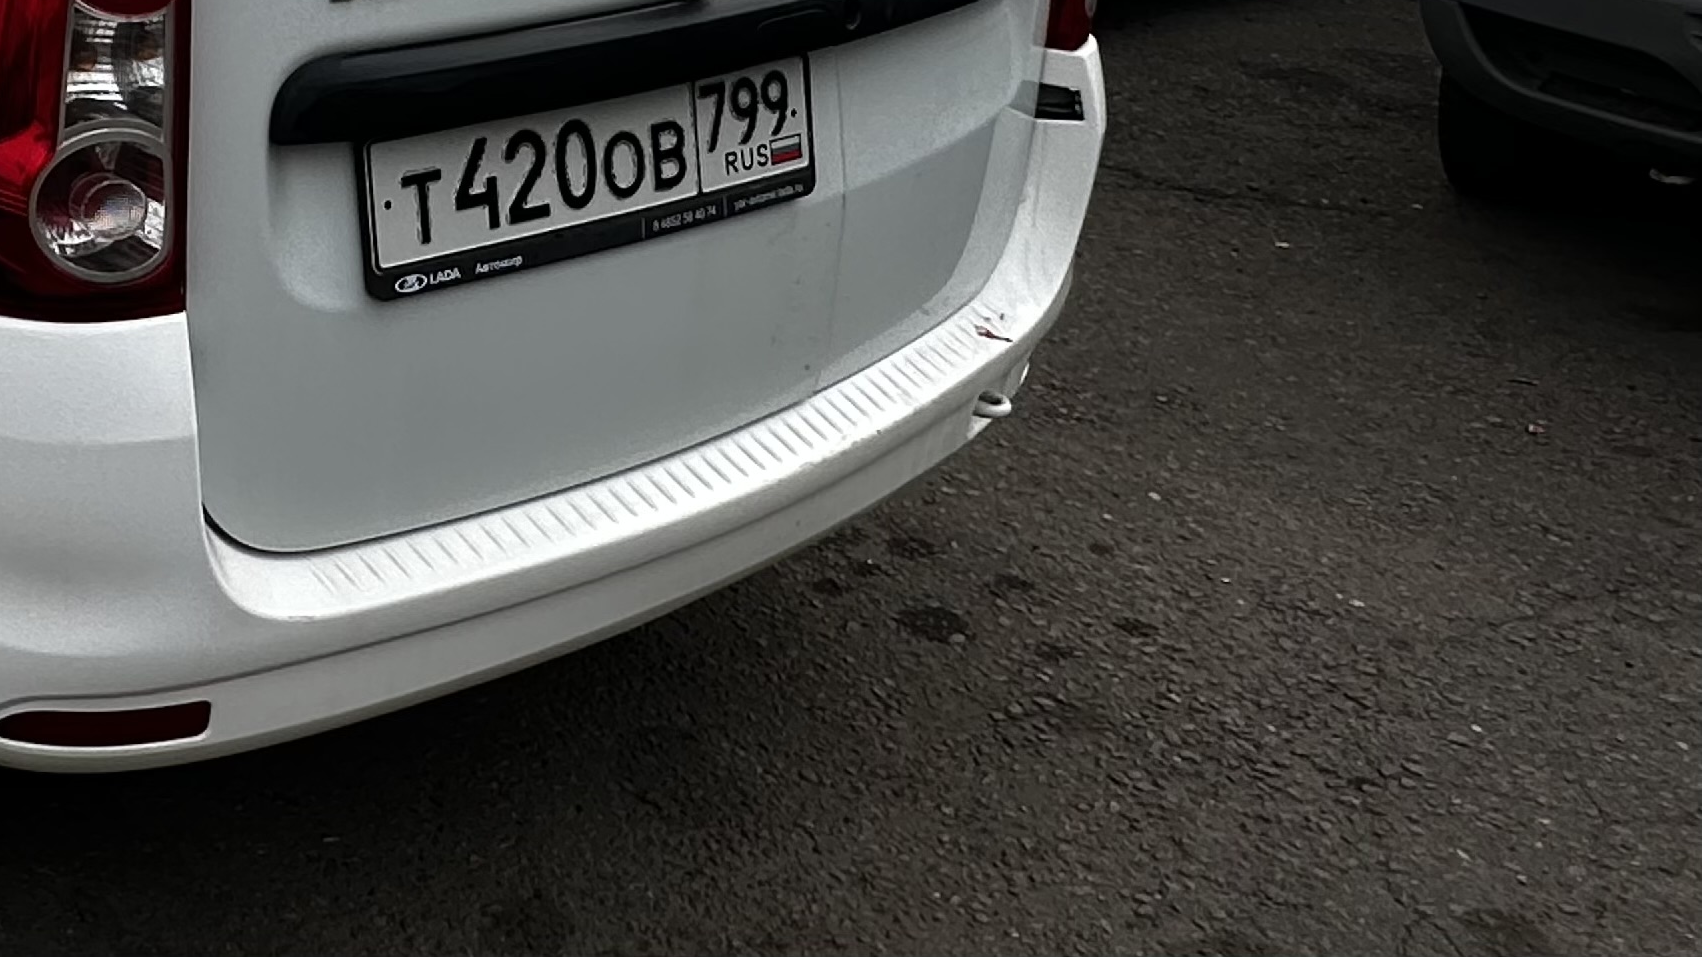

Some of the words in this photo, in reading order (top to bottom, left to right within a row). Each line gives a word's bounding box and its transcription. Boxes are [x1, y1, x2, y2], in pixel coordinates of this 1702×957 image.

[698, 69, 790, 154] 799
[724, 144, 769, 177] RUS
[429, 267, 461, 285] LADA
